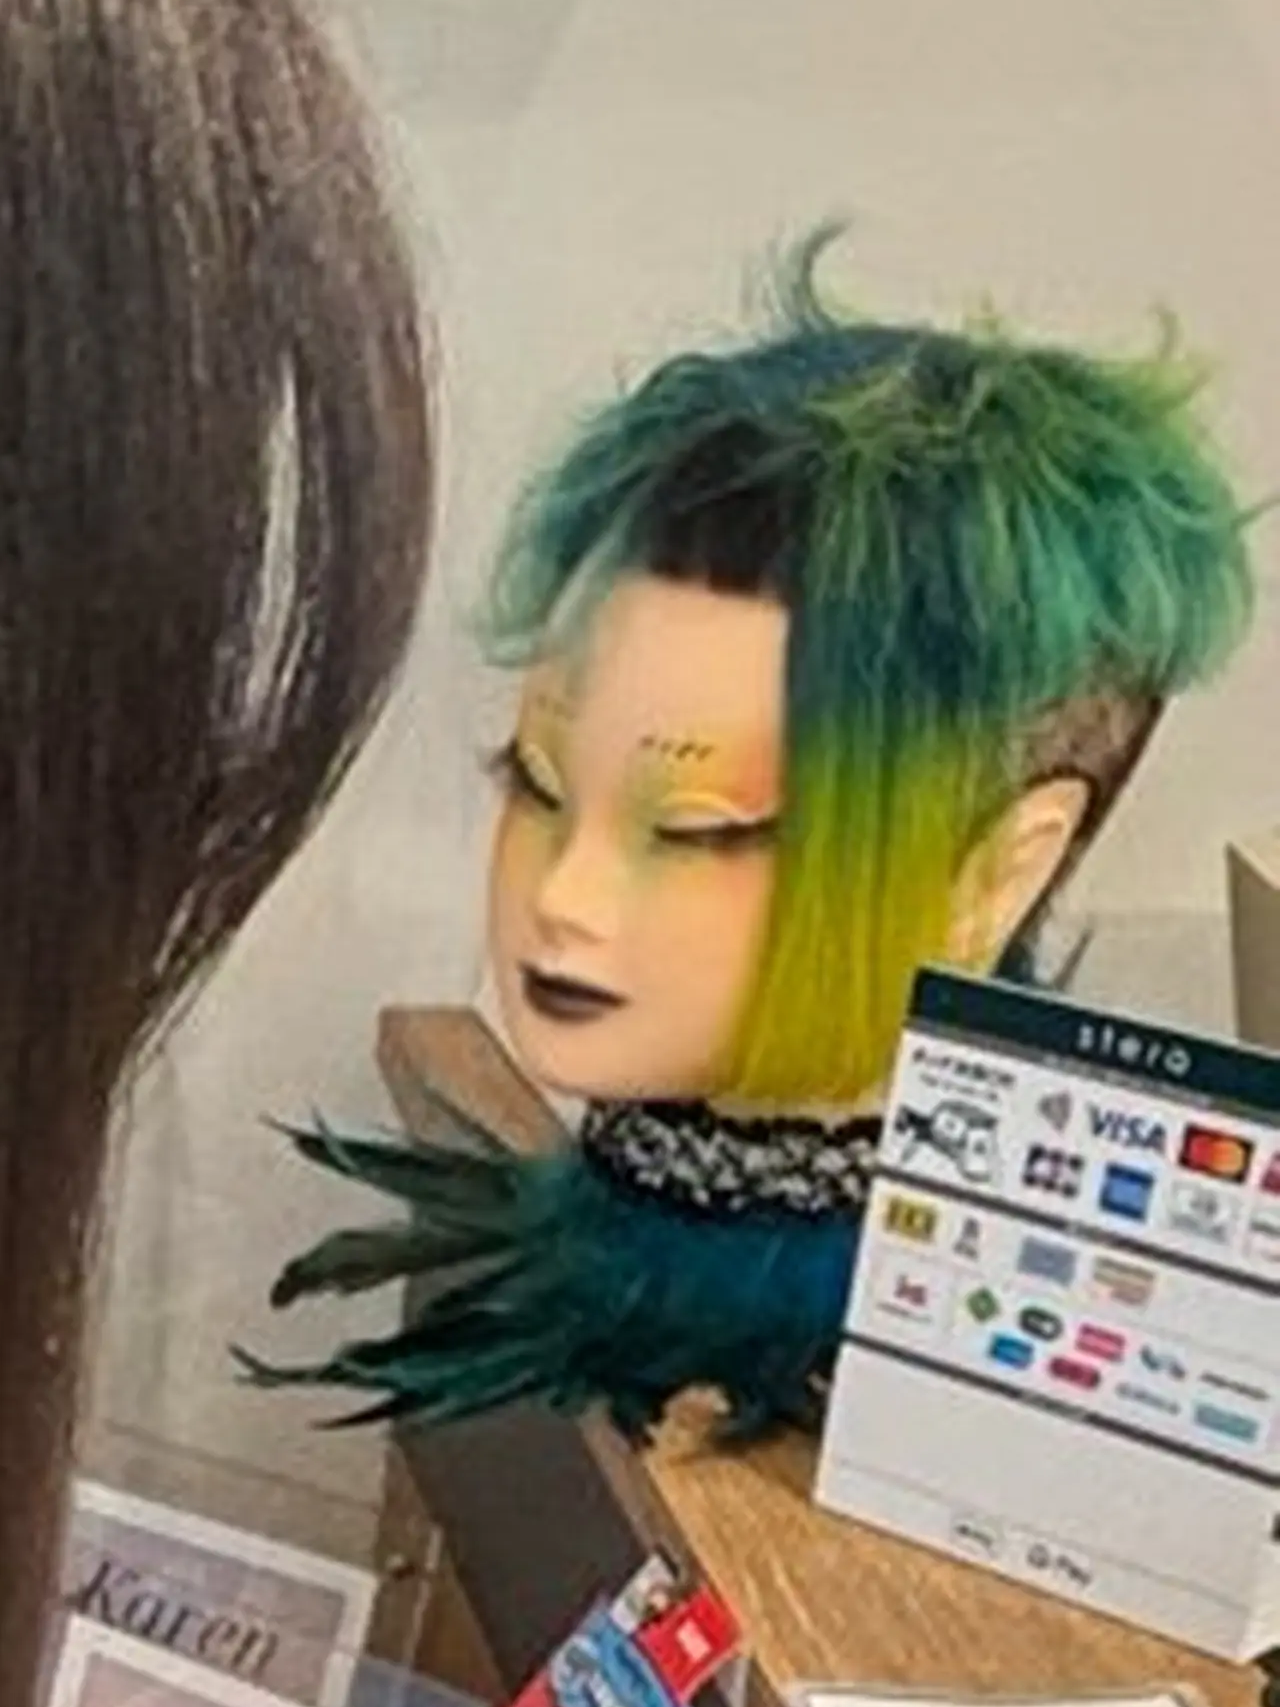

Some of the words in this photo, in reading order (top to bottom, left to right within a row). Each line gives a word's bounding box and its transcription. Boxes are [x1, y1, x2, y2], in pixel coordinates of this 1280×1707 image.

[1076, 1023, 1193, 1079] stera
[1087, 1100, 1168, 1155] VISA
[78, 1559, 281, 1679] Karen
